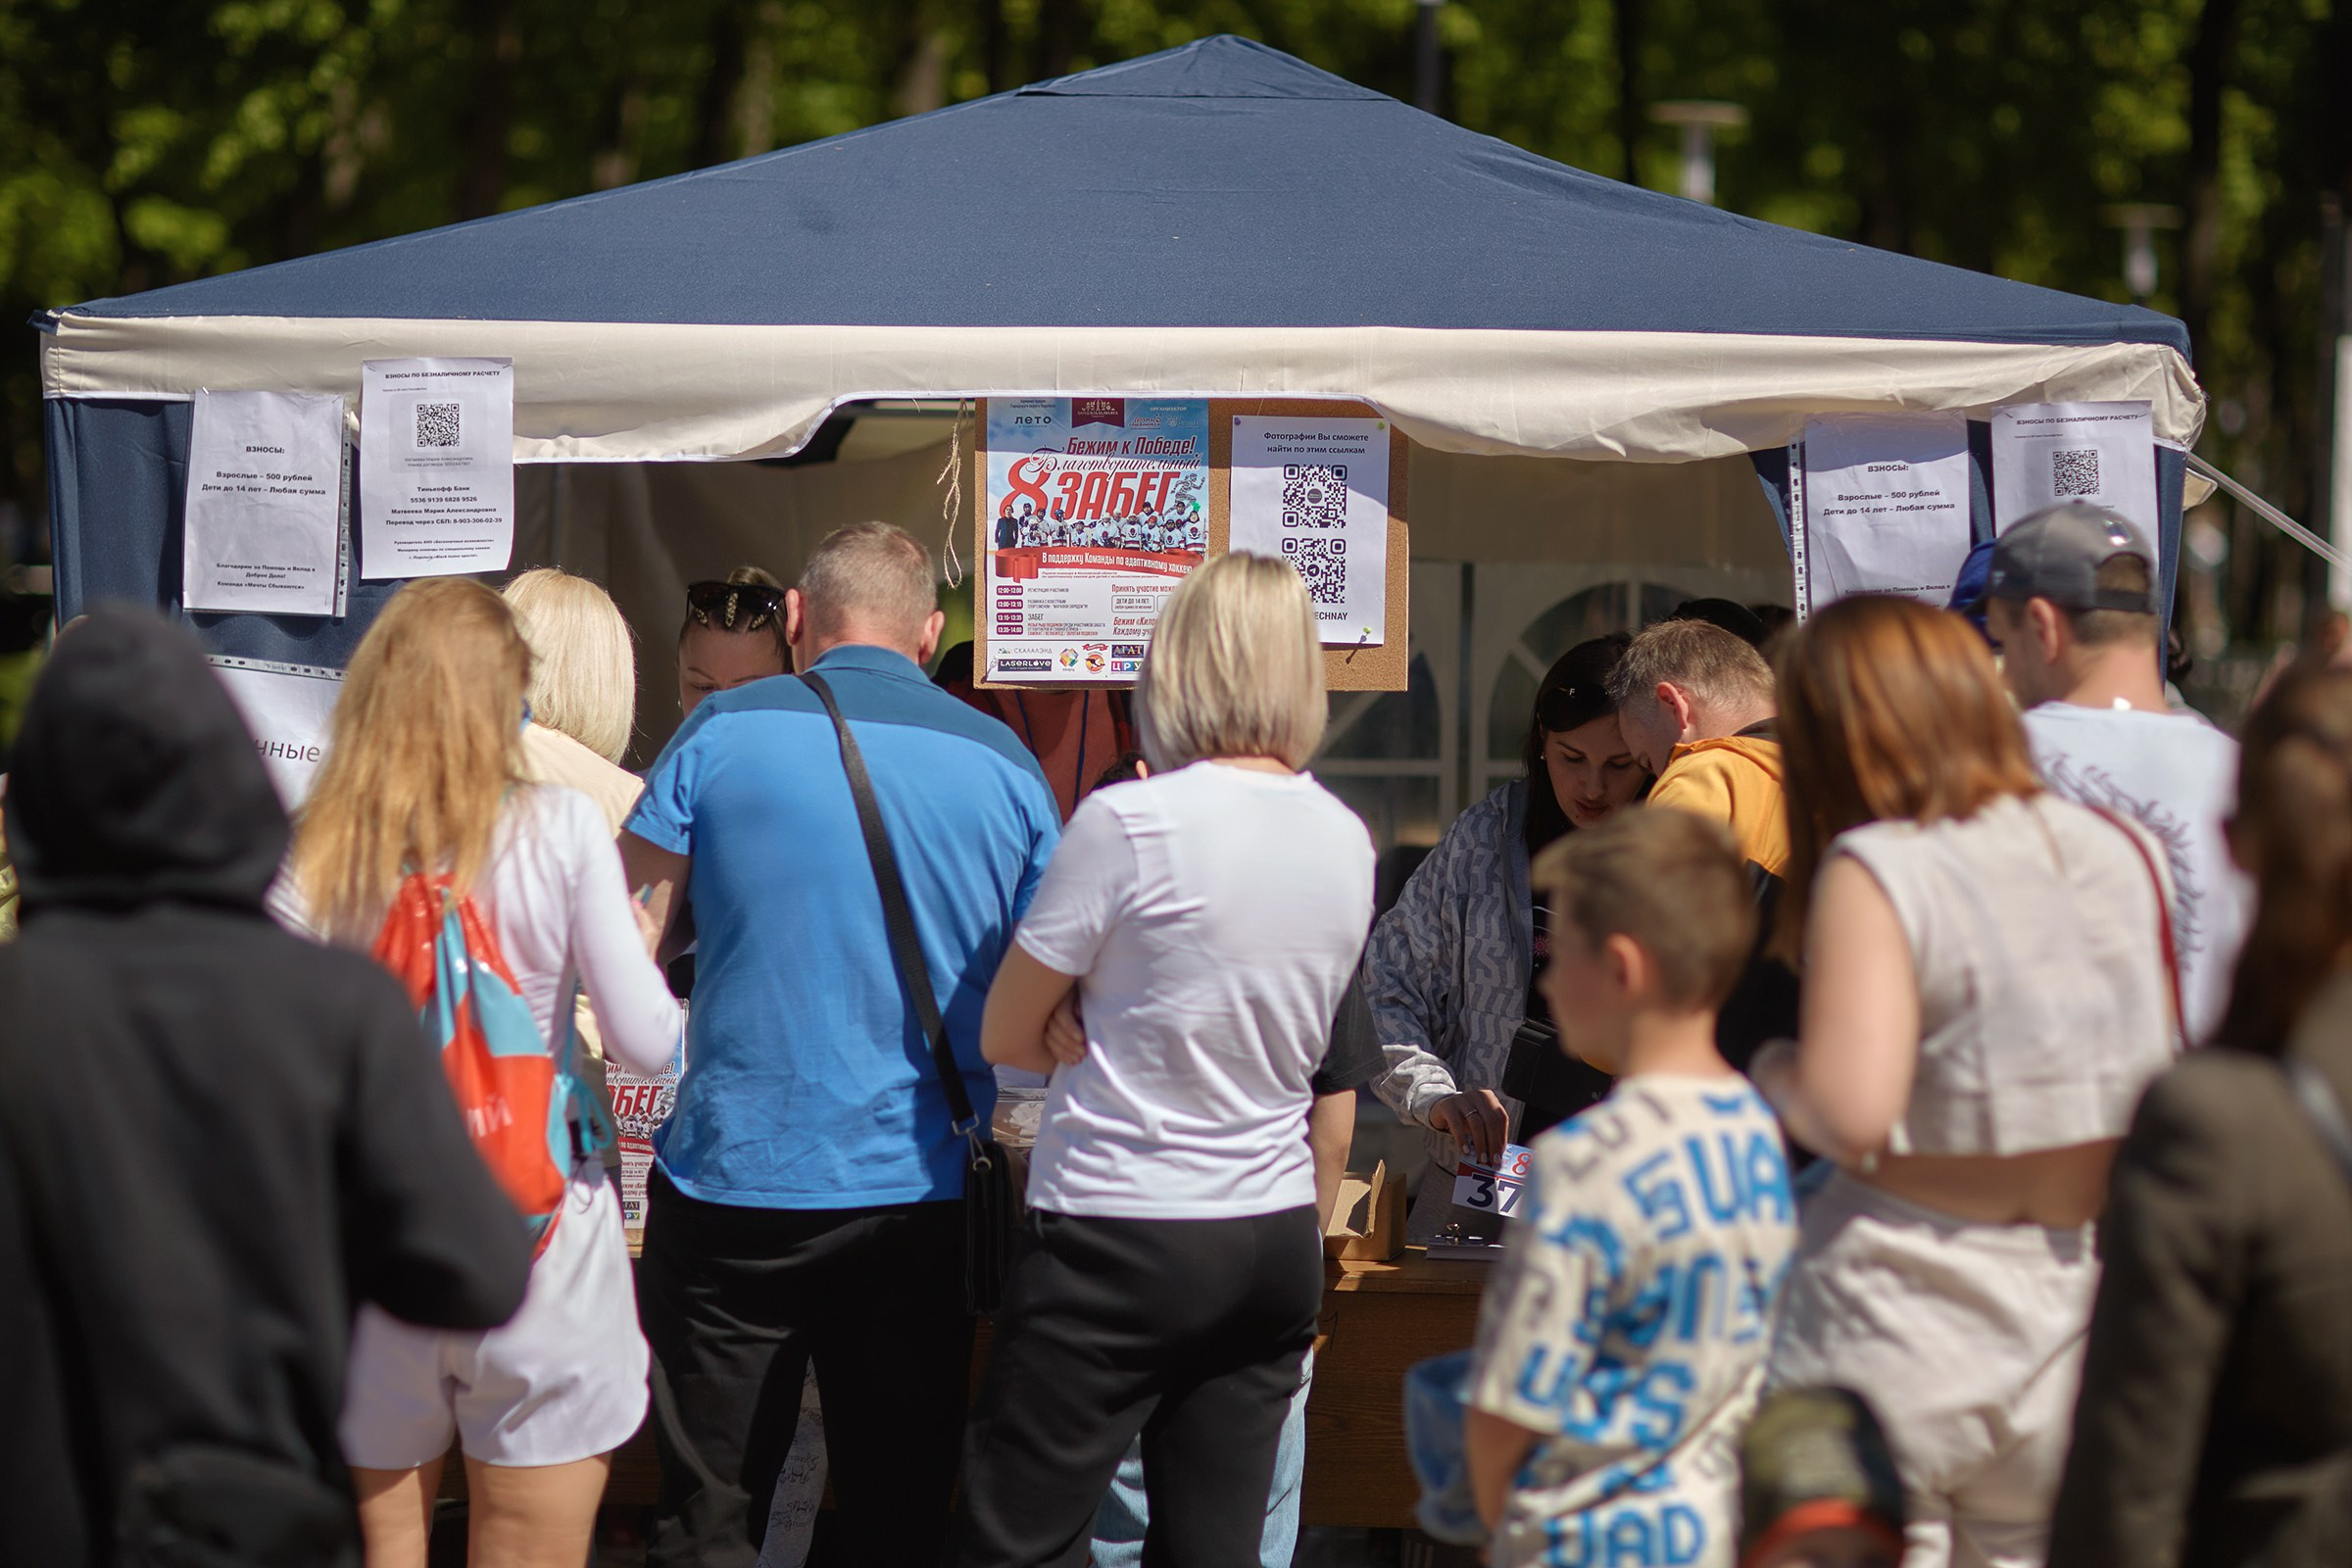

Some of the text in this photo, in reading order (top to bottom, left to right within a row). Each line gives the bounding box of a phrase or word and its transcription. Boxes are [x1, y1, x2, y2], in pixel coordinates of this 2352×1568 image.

[1264, 432, 1315, 441] Фотографии
[246, 446, 285, 454] ВЗНОСЫ:
[1066, 436, 1196, 455] Бежим к Победе!
[1026, 445, 1203, 480] Благотворительный
[216, 471, 257, 480] Взрослые
[283, 474, 312, 482] рублей
[999, 457, 1181, 520] 8 ЗАБЕГ
[1042, 552, 1047, 563] В
[1048, 554, 1083, 564] поддержку
[1085, 553, 1115, 564] Команды
[1116, 555, 1124, 564] по
[1125, 558, 1167, 572] адаптивному
[1112, 584, 1135, 593] Принять
[1113, 617, 1135, 626] Бежим
[1314, 612, 1348, 620] ECHNAY
[1113, 645, 1142, 655] АГАТ
[1113, 663, 1142, 671] ЦРУ
[255, 739, 320, 762] чные
[607, 1086, 663, 1116] БЕГ
[1512, 1152, 1533, 1175] 8
